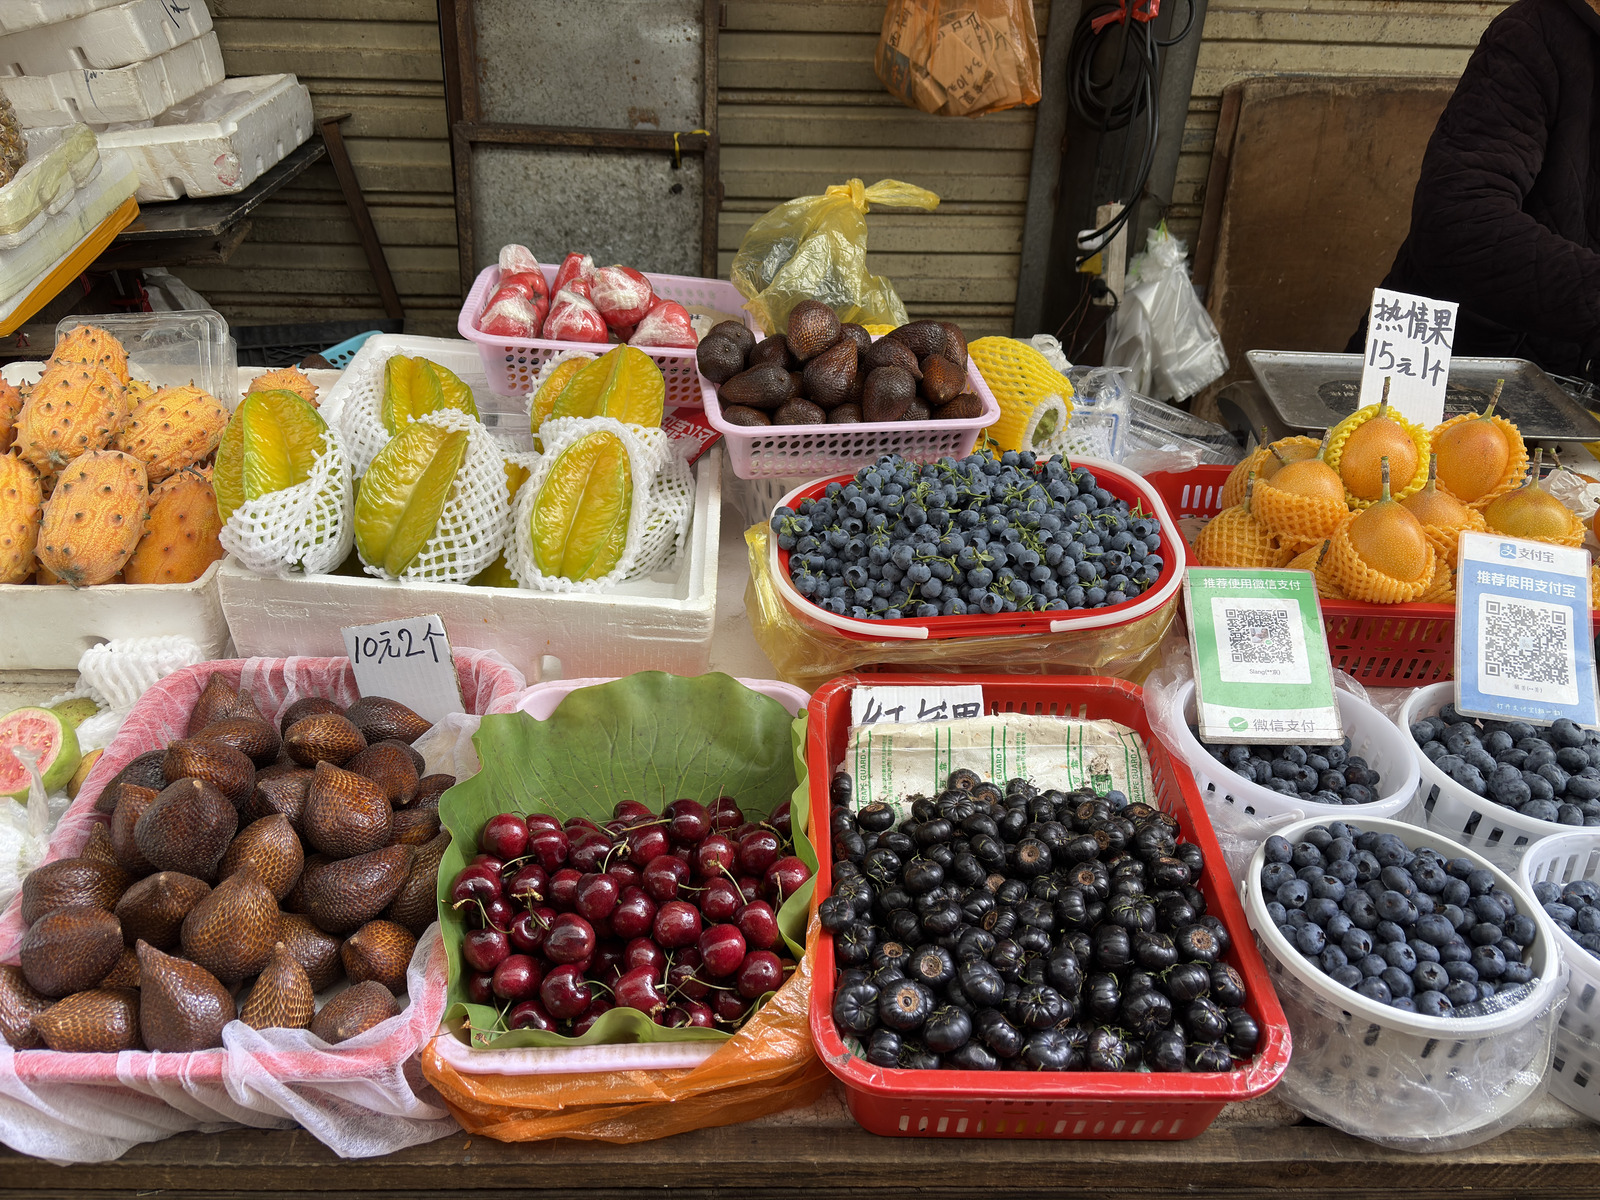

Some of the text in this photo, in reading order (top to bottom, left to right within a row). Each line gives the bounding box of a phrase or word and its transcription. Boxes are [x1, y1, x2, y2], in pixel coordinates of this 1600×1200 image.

[1373, 297, 1452, 349] 热情果
[1369, 338, 1446, 387] 15元1个
[1518, 548, 1555, 564] 支付宝
[1203, 577, 1302, 591] 推荐使用微信支付
[1476, 570, 1577, 598] 推荐使用支付宝
[354, 623, 445, 664] 10元2个
[1252, 718, 1316, 733] 微信支付
[995, 753, 1003, 780] GUARD
